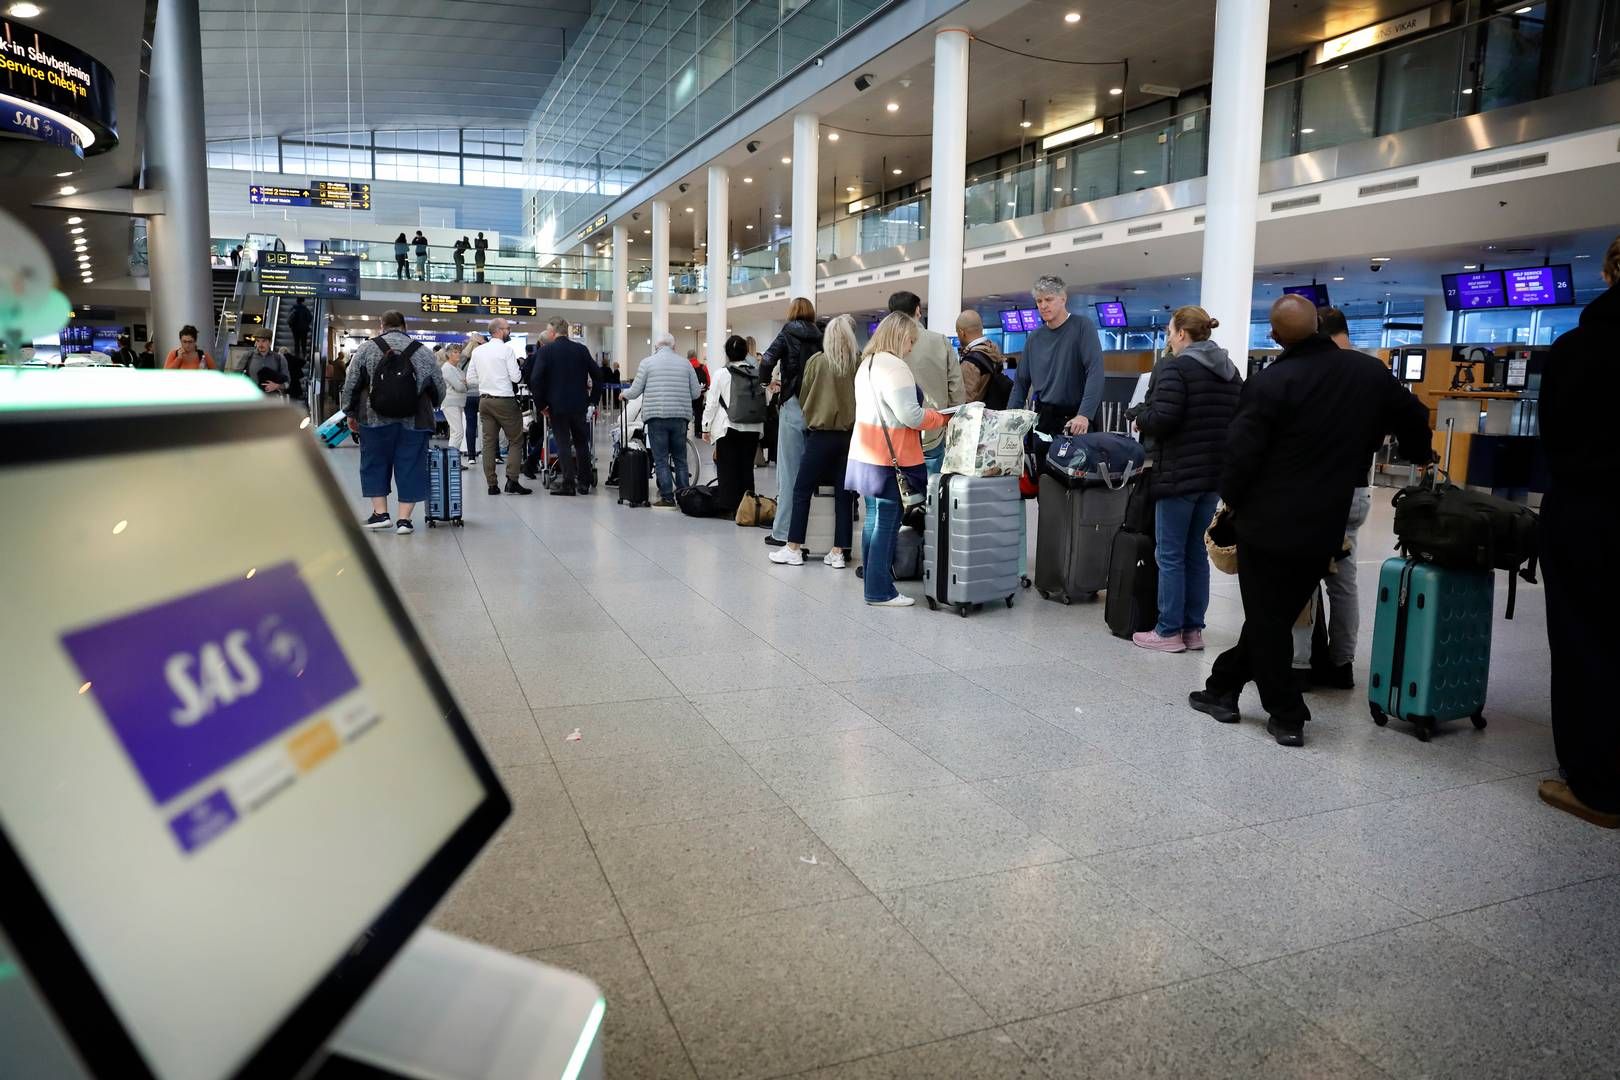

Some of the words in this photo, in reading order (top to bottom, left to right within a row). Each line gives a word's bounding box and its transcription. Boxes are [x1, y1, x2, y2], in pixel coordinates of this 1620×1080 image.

[28, 46, 91, 87] Selvbetjening
[48, 71, 87, 97] Check-in
[13, 111, 40, 131] SAS
[1557, 281, 1568, 289] 26
[461, 296, 471, 304] 50
[512, 307, 518, 315] 2
[163, 629, 262, 728] SAS
